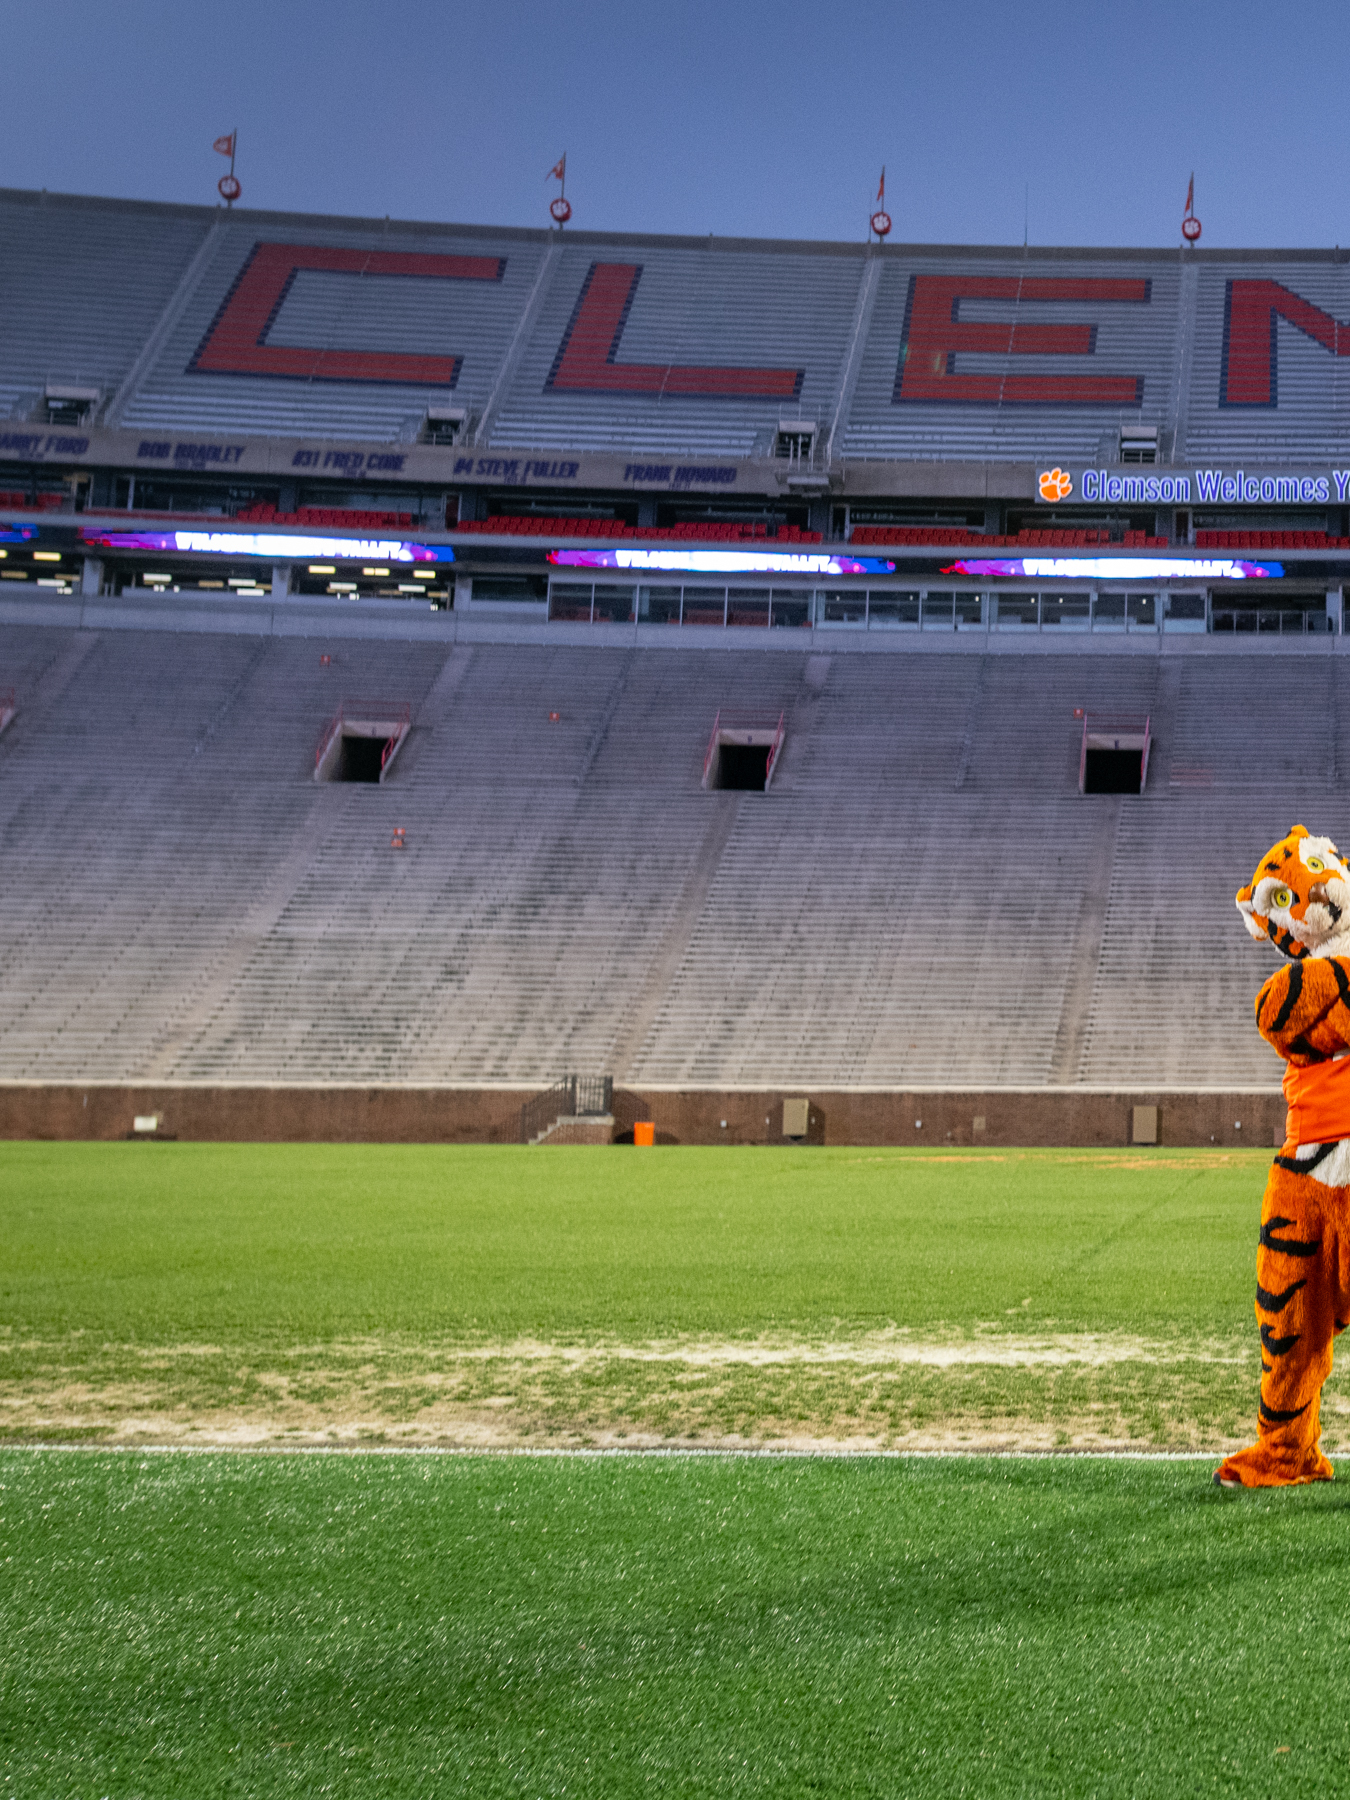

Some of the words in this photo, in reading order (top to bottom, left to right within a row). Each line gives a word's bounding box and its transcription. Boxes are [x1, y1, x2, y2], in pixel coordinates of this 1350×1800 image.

[475, 459, 522, 476] STEVE
[522, 460, 580, 478] FULLER
[623, 463, 673, 481] FRANK
[1082, 469, 1190, 502] Clemson
[1195, 469, 1329, 502] Welcomes
